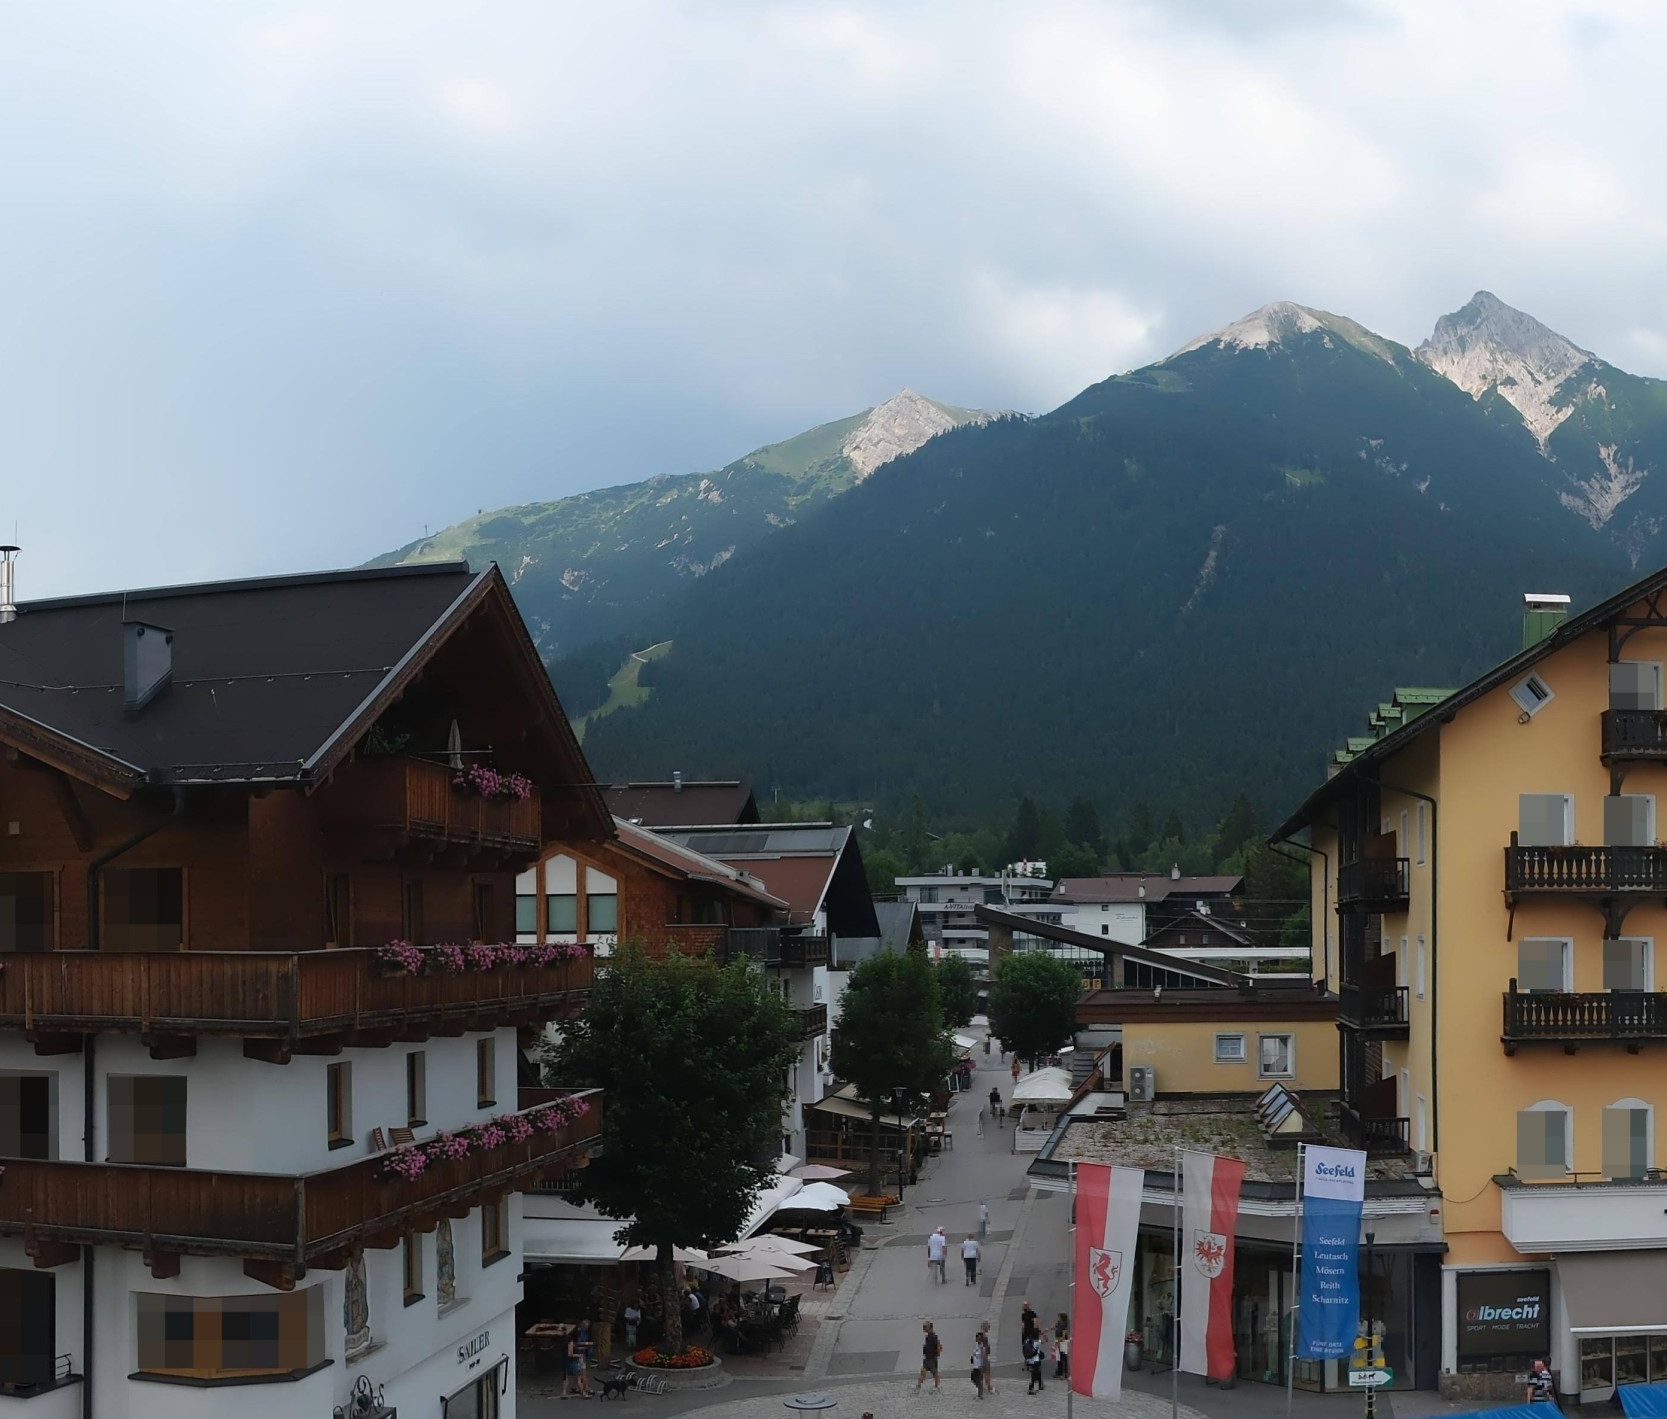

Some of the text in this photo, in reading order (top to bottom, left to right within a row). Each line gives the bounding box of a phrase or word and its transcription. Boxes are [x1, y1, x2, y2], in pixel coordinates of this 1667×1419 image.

[1315, 1162, 1355, 1178] Seefeld
[1319, 1236, 1345, 1246] Seefeld
[1314, 1251, 1348, 1261] Leutasch
[1316, 1265, 1345, 1275] Mösern
[1320, 1280, 1340, 1289] Reith
[1312, 1294, 1349, 1304] Scharnitz
